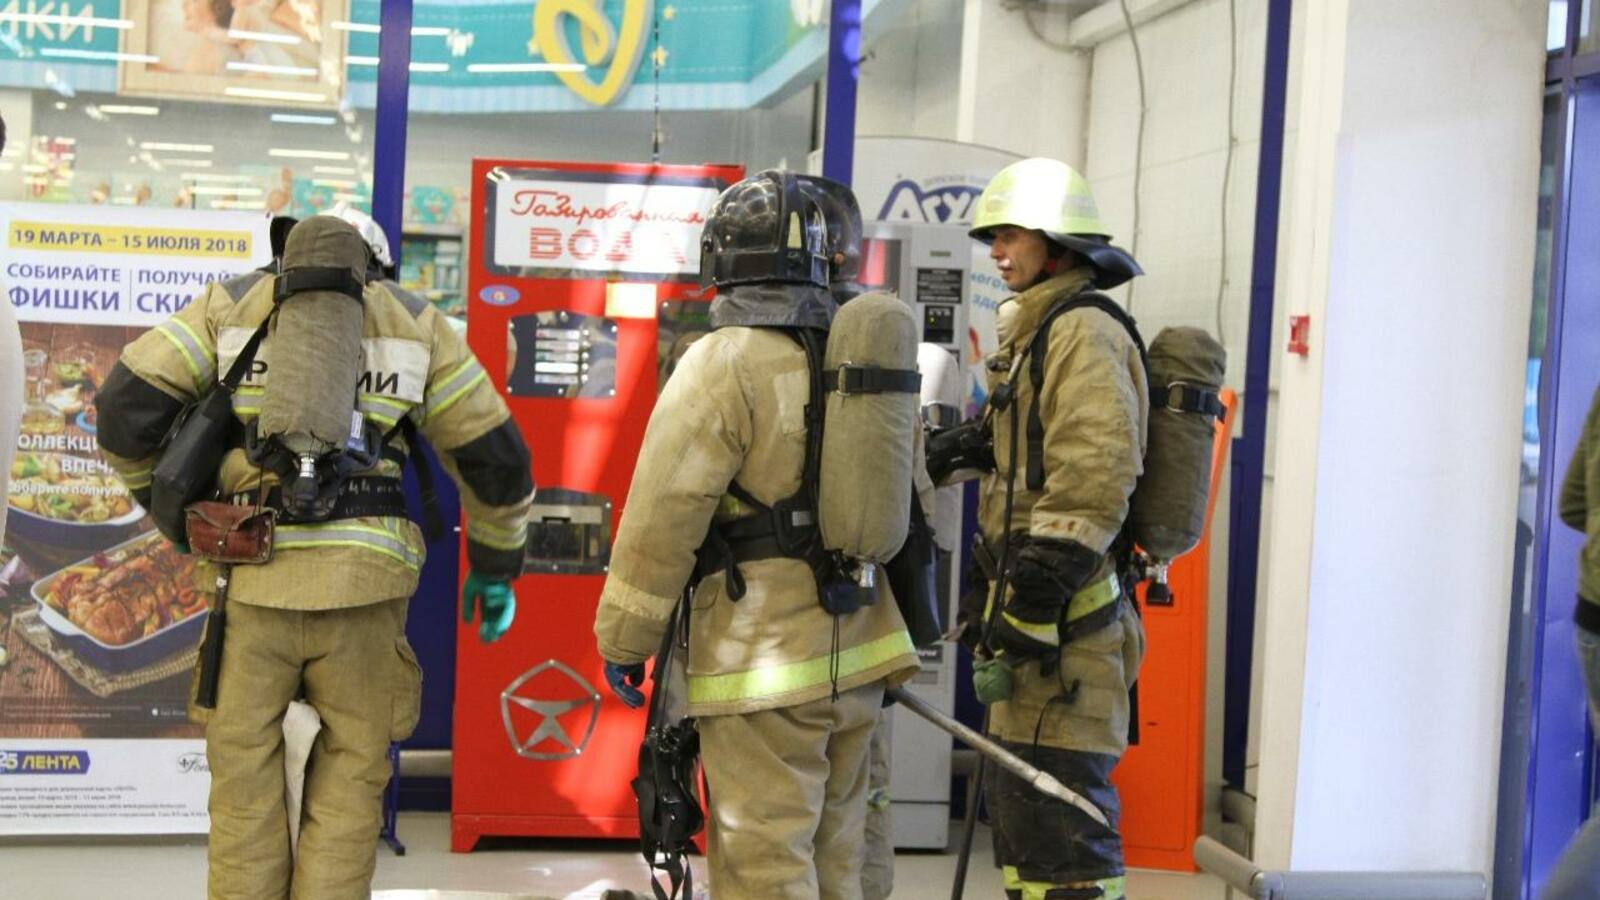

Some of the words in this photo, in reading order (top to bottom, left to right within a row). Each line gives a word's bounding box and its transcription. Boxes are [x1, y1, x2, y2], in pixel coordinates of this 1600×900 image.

[14, 229, 35, 243] 19
[39, 230, 103, 246] МАРТА
[122, 235, 142, 248] 15
[146, 236, 201, 250] ИЮЛЯ
[205, 238, 247, 253] 2018
[529, 226, 687, 264] ВОД
[7, 262, 121, 283] СОБИРАЙТЕ
[138, 269, 239, 286] ПОЛУЧАЙ
[9, 285, 120, 312] ФИШКИ
[136, 292, 193, 313] СКИ
[18, 434, 98, 453] ОЛЛЕКЦ
[22, 754, 81, 770] ЛЕНТА
